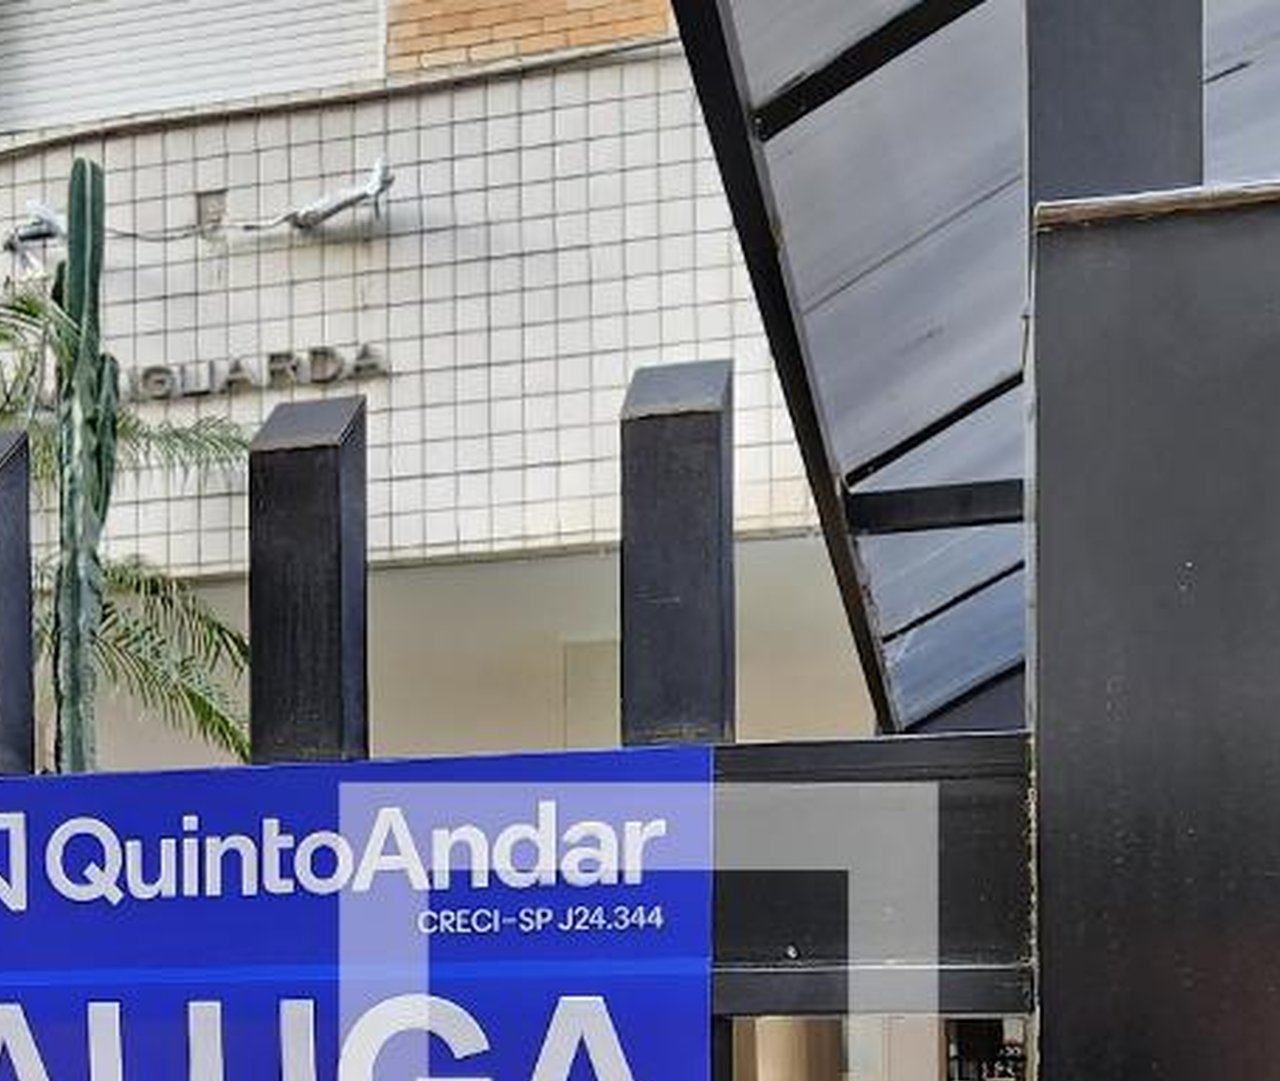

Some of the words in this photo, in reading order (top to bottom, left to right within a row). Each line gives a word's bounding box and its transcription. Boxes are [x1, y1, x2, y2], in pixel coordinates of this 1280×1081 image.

[46, 800, 666, 904] QuintoAndar
[418, 907, 552, 936] CRECI-SP
[558, 904, 665, 933] J24.344
